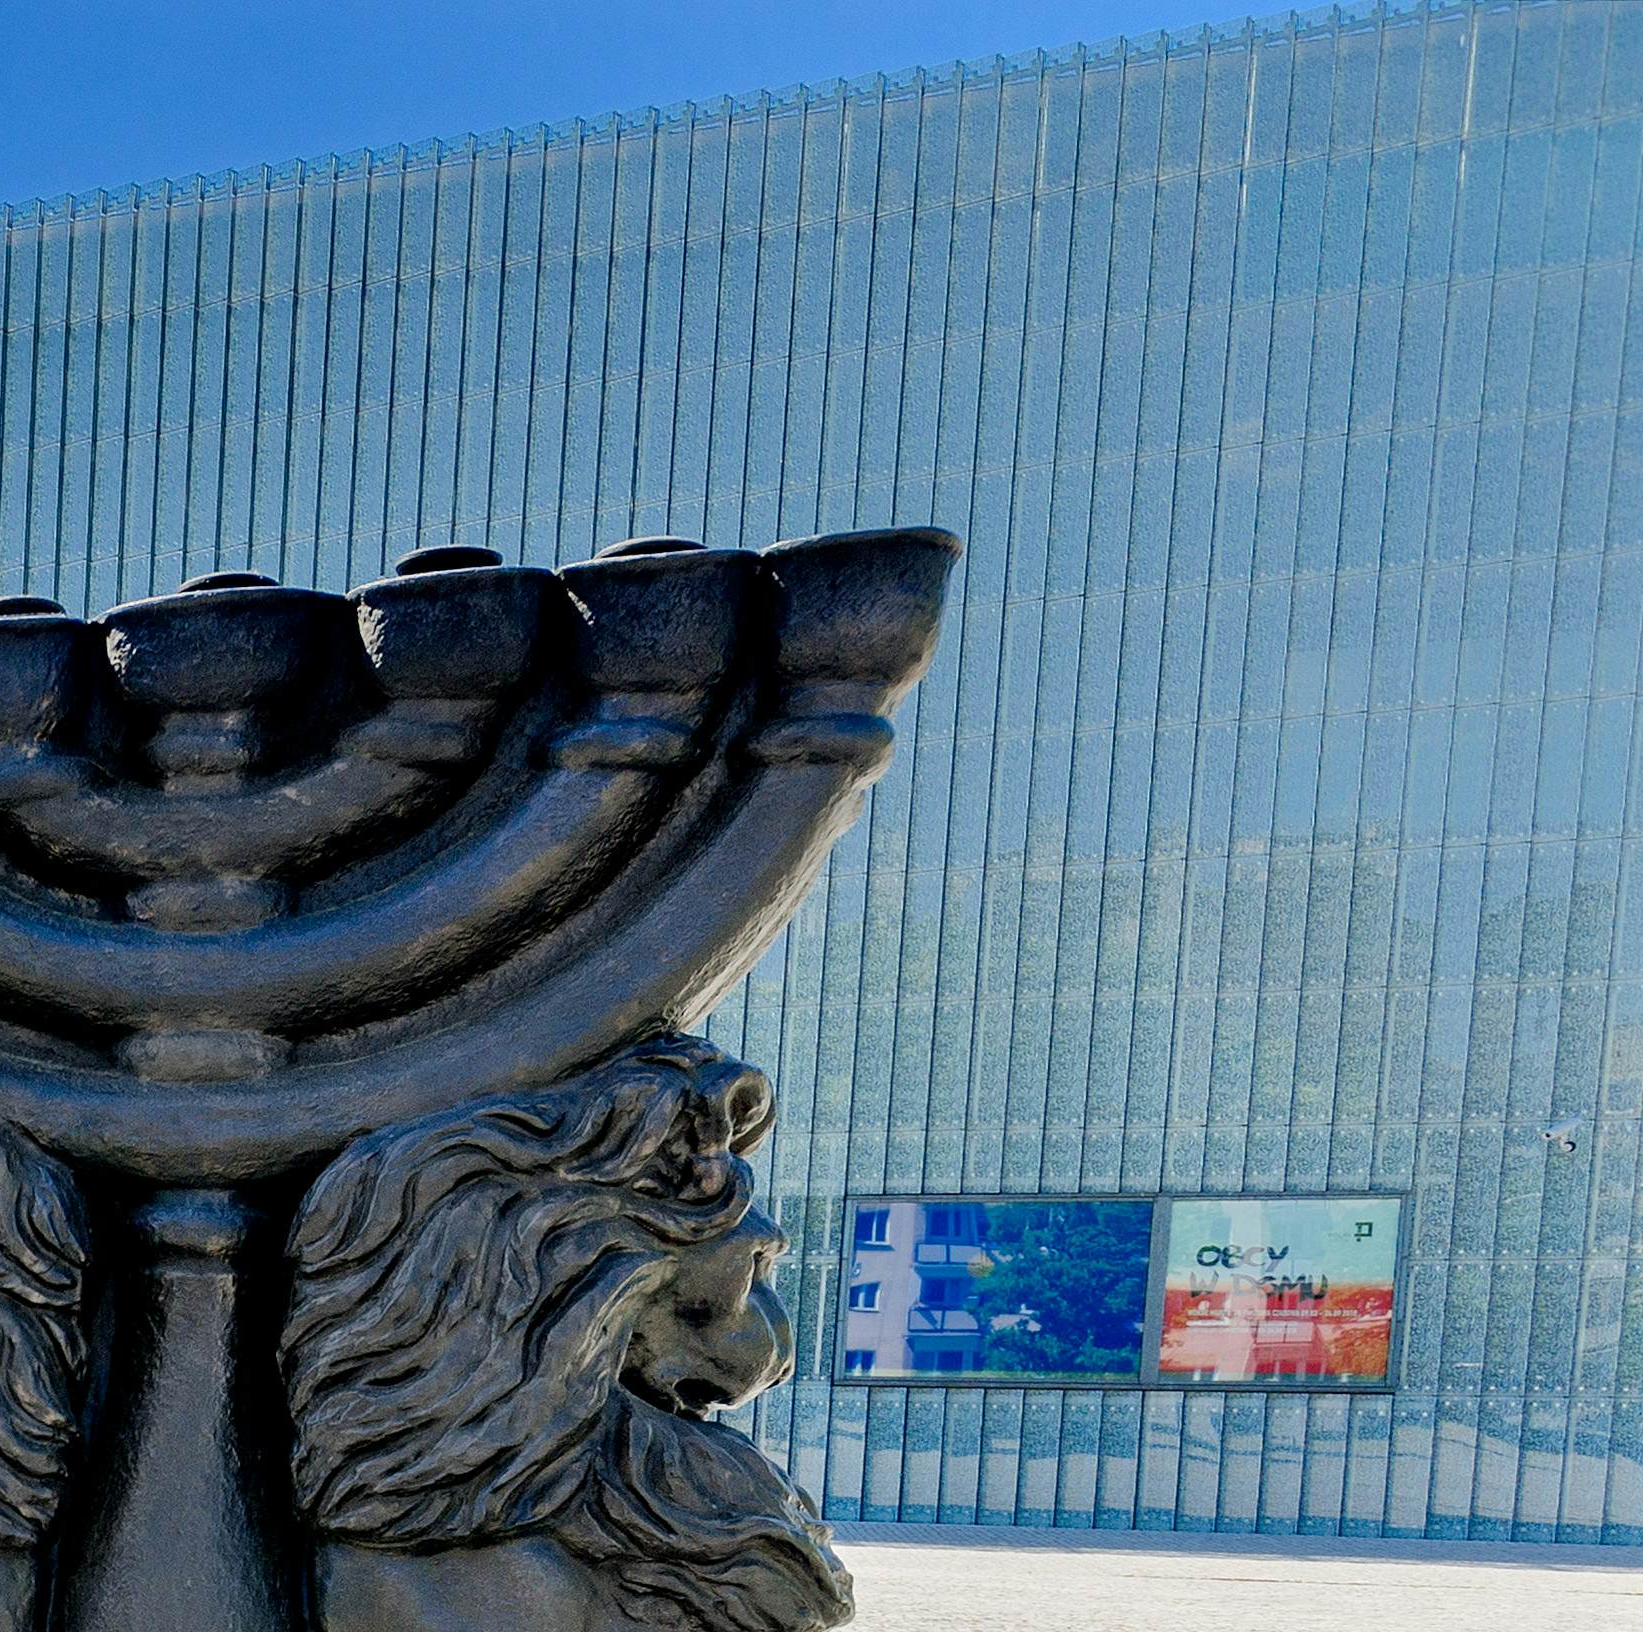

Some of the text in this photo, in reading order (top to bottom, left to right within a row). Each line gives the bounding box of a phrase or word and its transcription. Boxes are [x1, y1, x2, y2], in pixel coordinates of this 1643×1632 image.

[1196, 1244, 1290, 1273] OBCY
[1189, 1271, 1329, 1302] W DOMU
